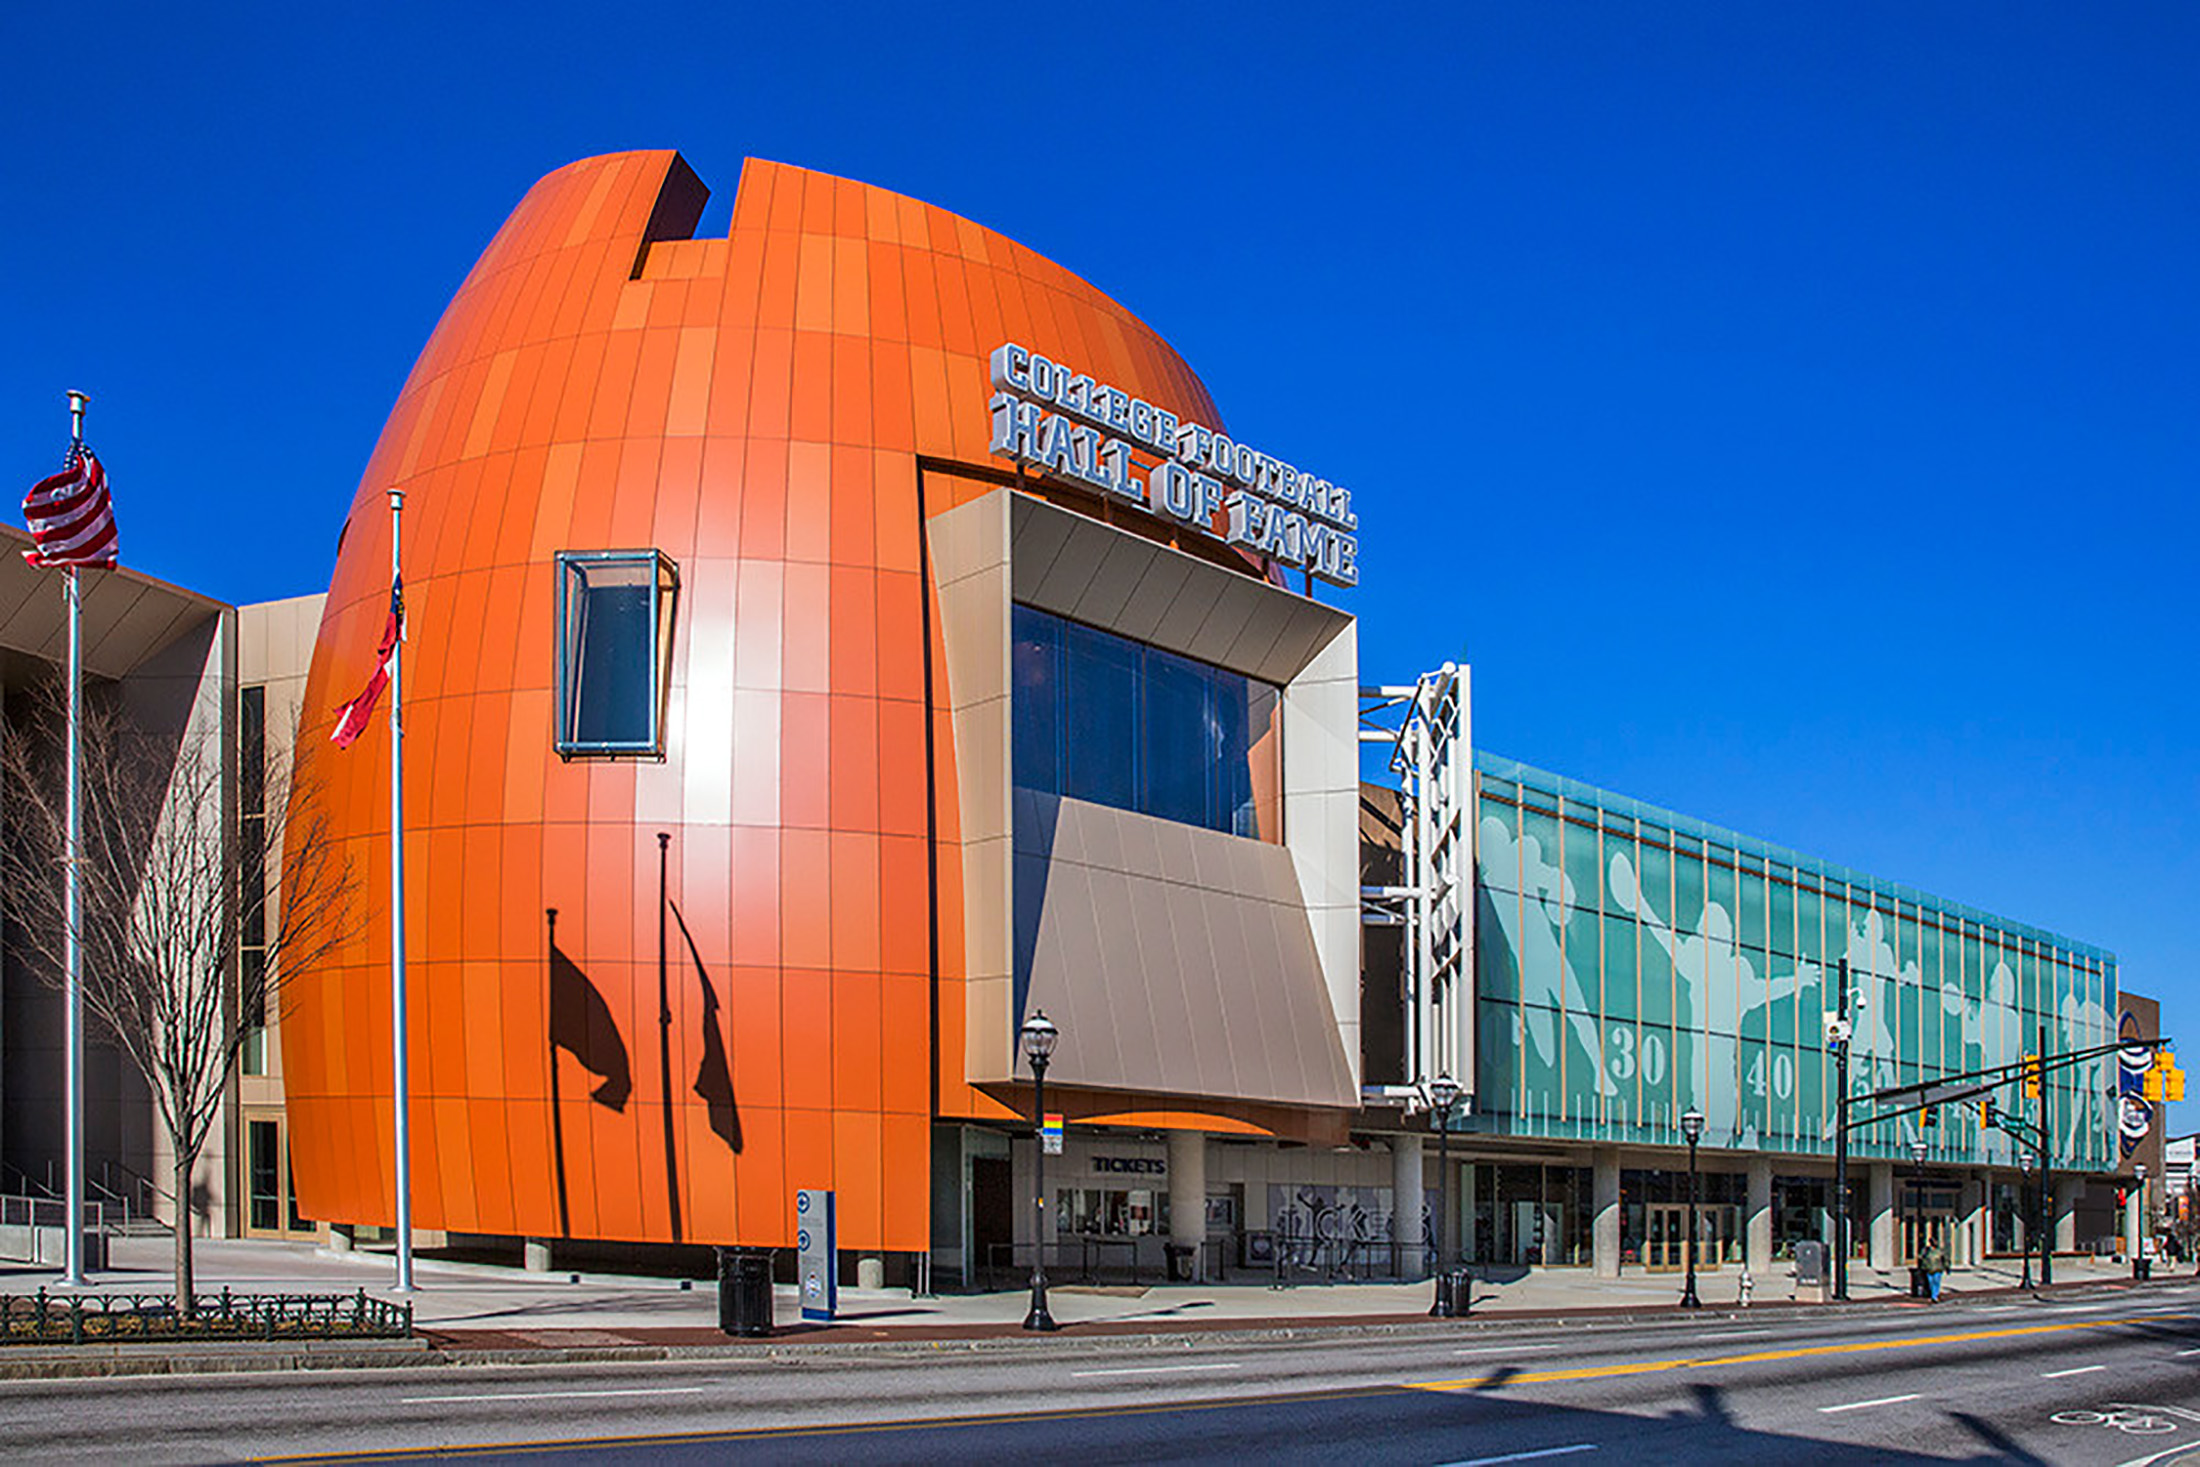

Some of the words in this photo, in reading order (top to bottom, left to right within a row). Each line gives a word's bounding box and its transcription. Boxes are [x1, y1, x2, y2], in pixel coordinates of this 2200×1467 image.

[992, 343, 1179, 455] COLLEGE
[1177, 422, 1358, 531] FOOTBALL
[990, 392, 1143, 504] HALL
[1150, 458, 1224, 532] OF
[1226, 490, 1359, 587] FAME
[1611, 1026, 1665, 1086] 30
[1747, 1049, 1794, 1100] 40
[1091, 1156, 1166, 1174] TICKETS
[1279, 1206, 1431, 1245] TICKE
